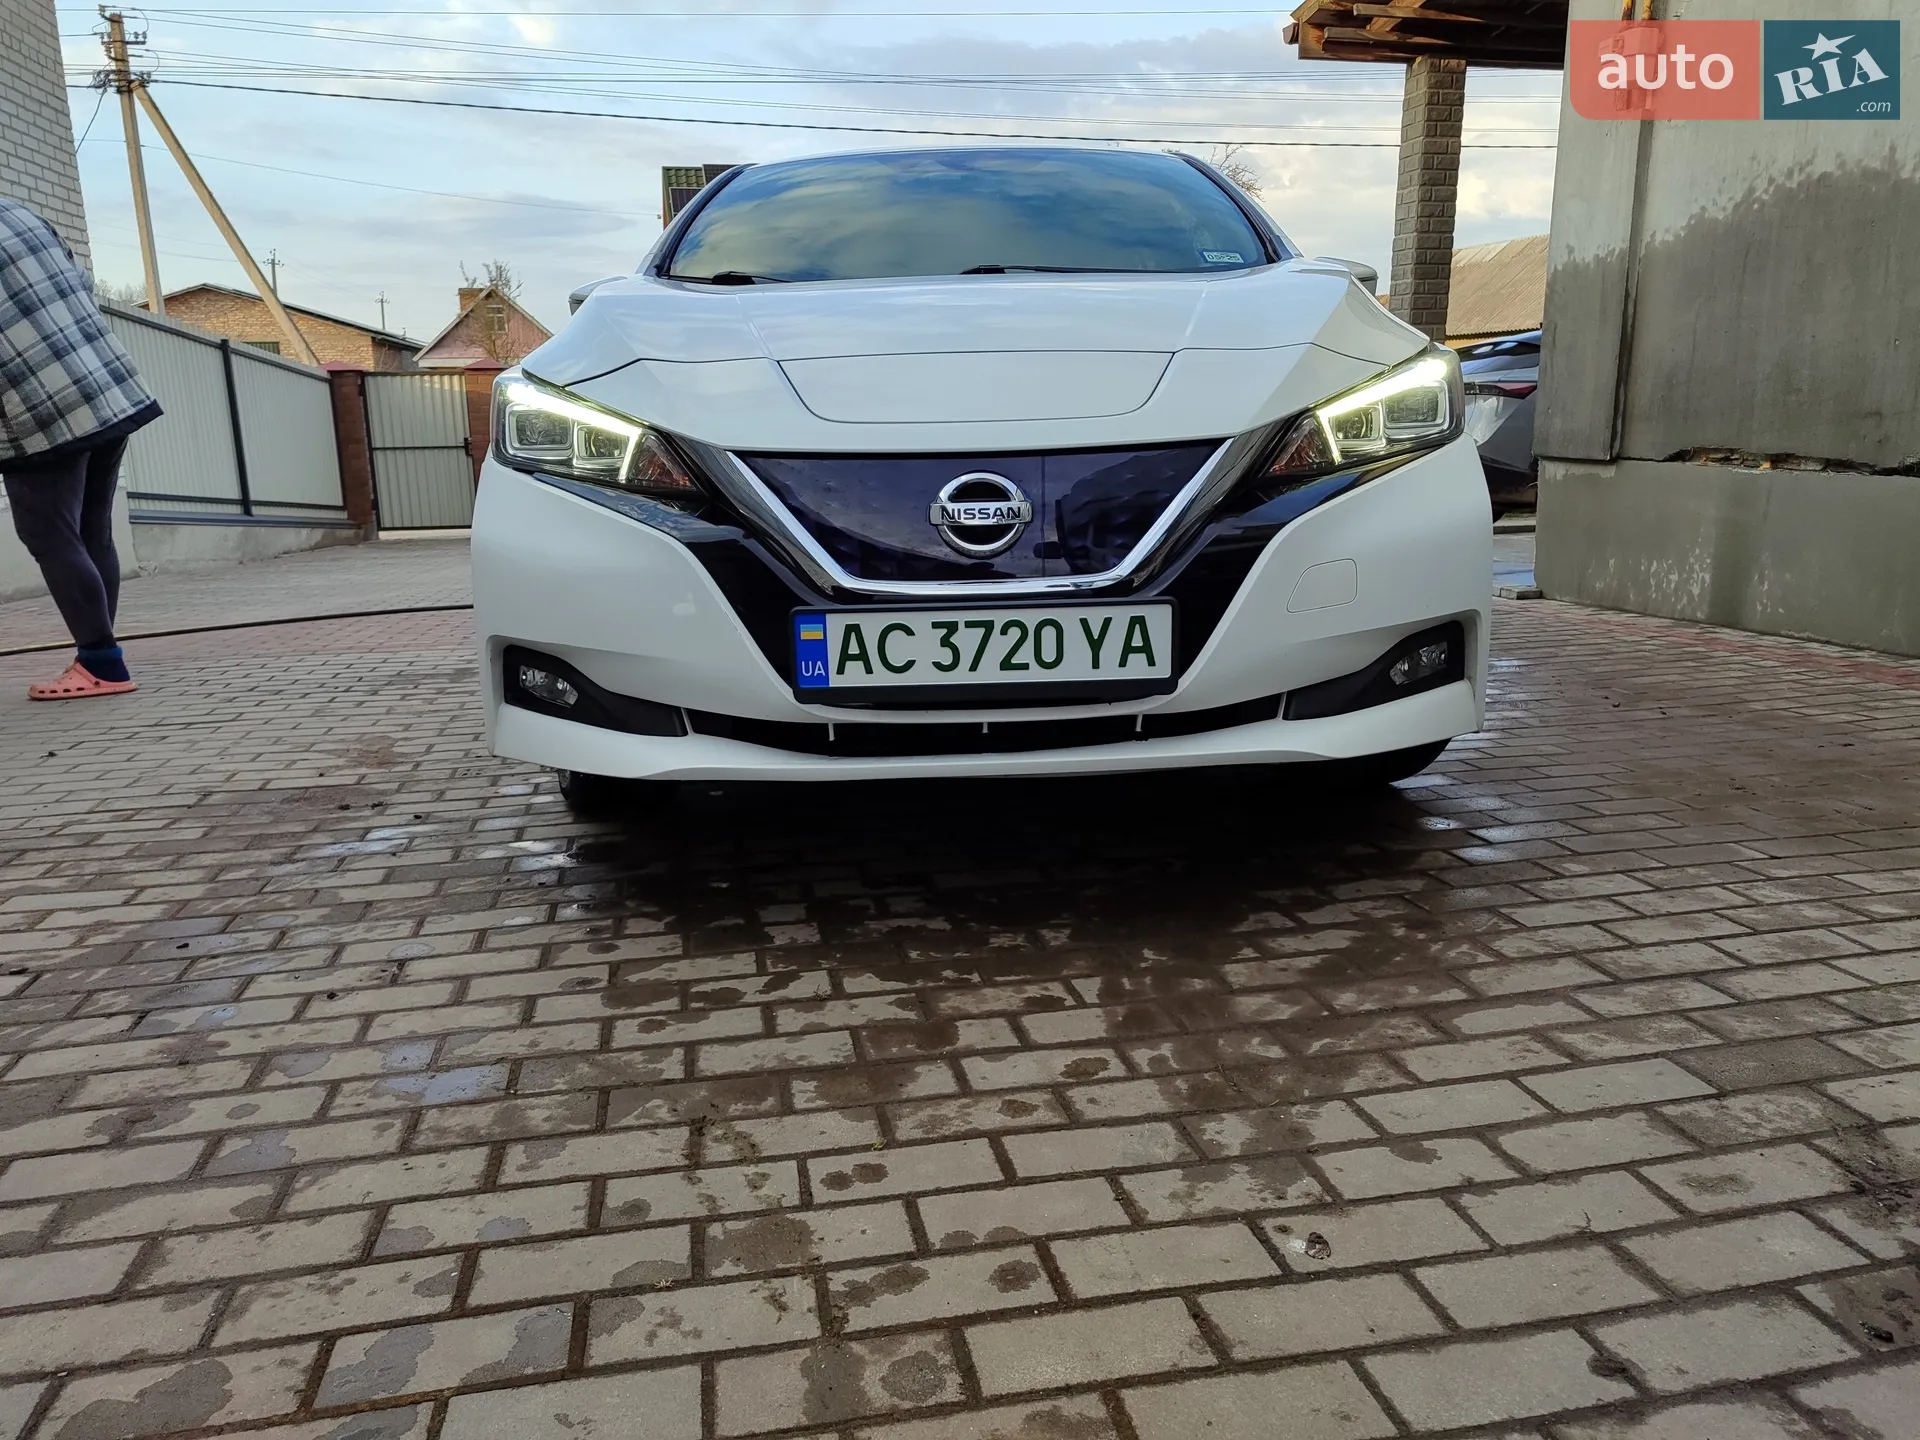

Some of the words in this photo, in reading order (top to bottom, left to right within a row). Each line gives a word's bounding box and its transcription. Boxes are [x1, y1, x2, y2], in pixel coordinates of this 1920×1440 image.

[941, 506, 1021, 521] NISSAN
[835, 622, 917, 676] AC
[930, 617, 1065, 673] 3720
[1078, 614, 1157, 670] YA
[801, 661, 826, 677] UA
